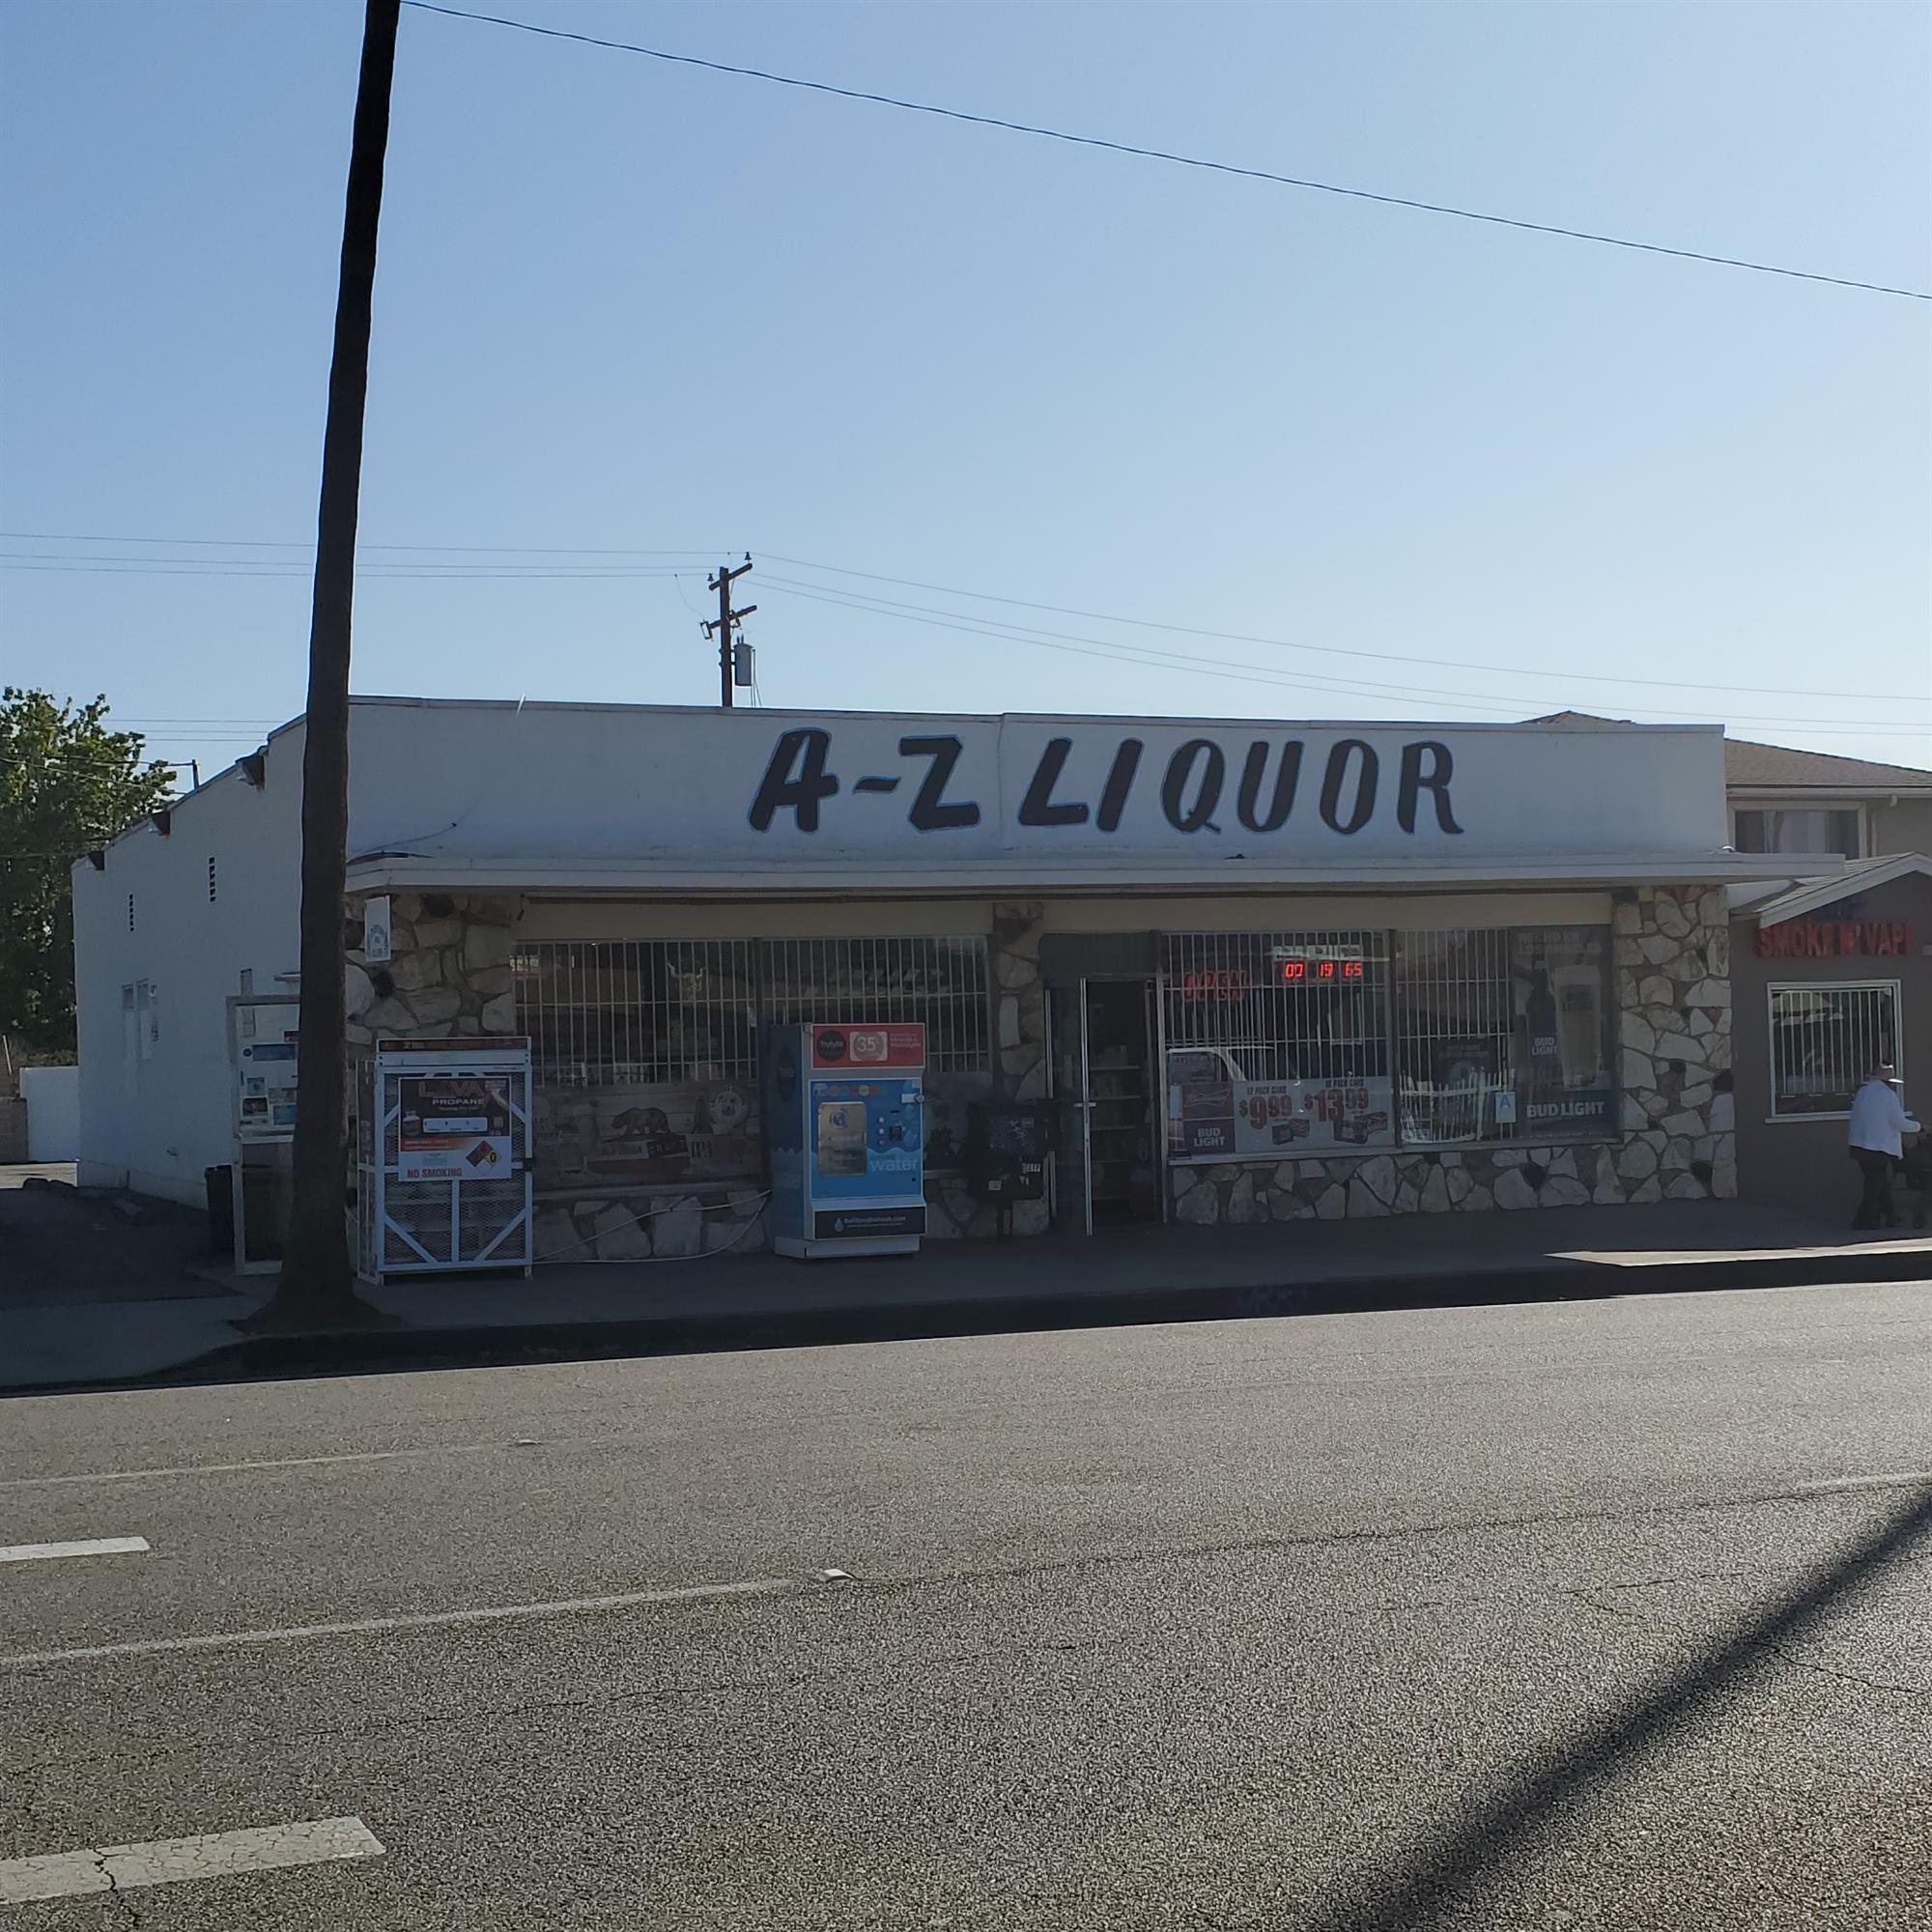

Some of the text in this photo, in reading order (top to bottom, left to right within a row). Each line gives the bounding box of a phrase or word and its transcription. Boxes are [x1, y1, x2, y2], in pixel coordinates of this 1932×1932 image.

[748, 726, 1464, 837] A-Z LIQUOR
[1758, 921, 1834, 958] SMOKE
[1534, 1037, 1555, 1046] BUD
[1531, 1044, 1558, 1056] LIGHT
[432, 1097, 485, 1106] PROPANE
[1499, 1094, 1512, 1109] A
[1525, 1100, 1605, 1119] BUD LIGHT
[1197, 1127, 1222, 1139] BUD
[1193, 1137, 1227, 1148] LIGHT
[490, 1151, 497, 1163] 0
[870, 1158, 918, 1172] water
[407, 1167, 463, 1179] NO SMOKING
